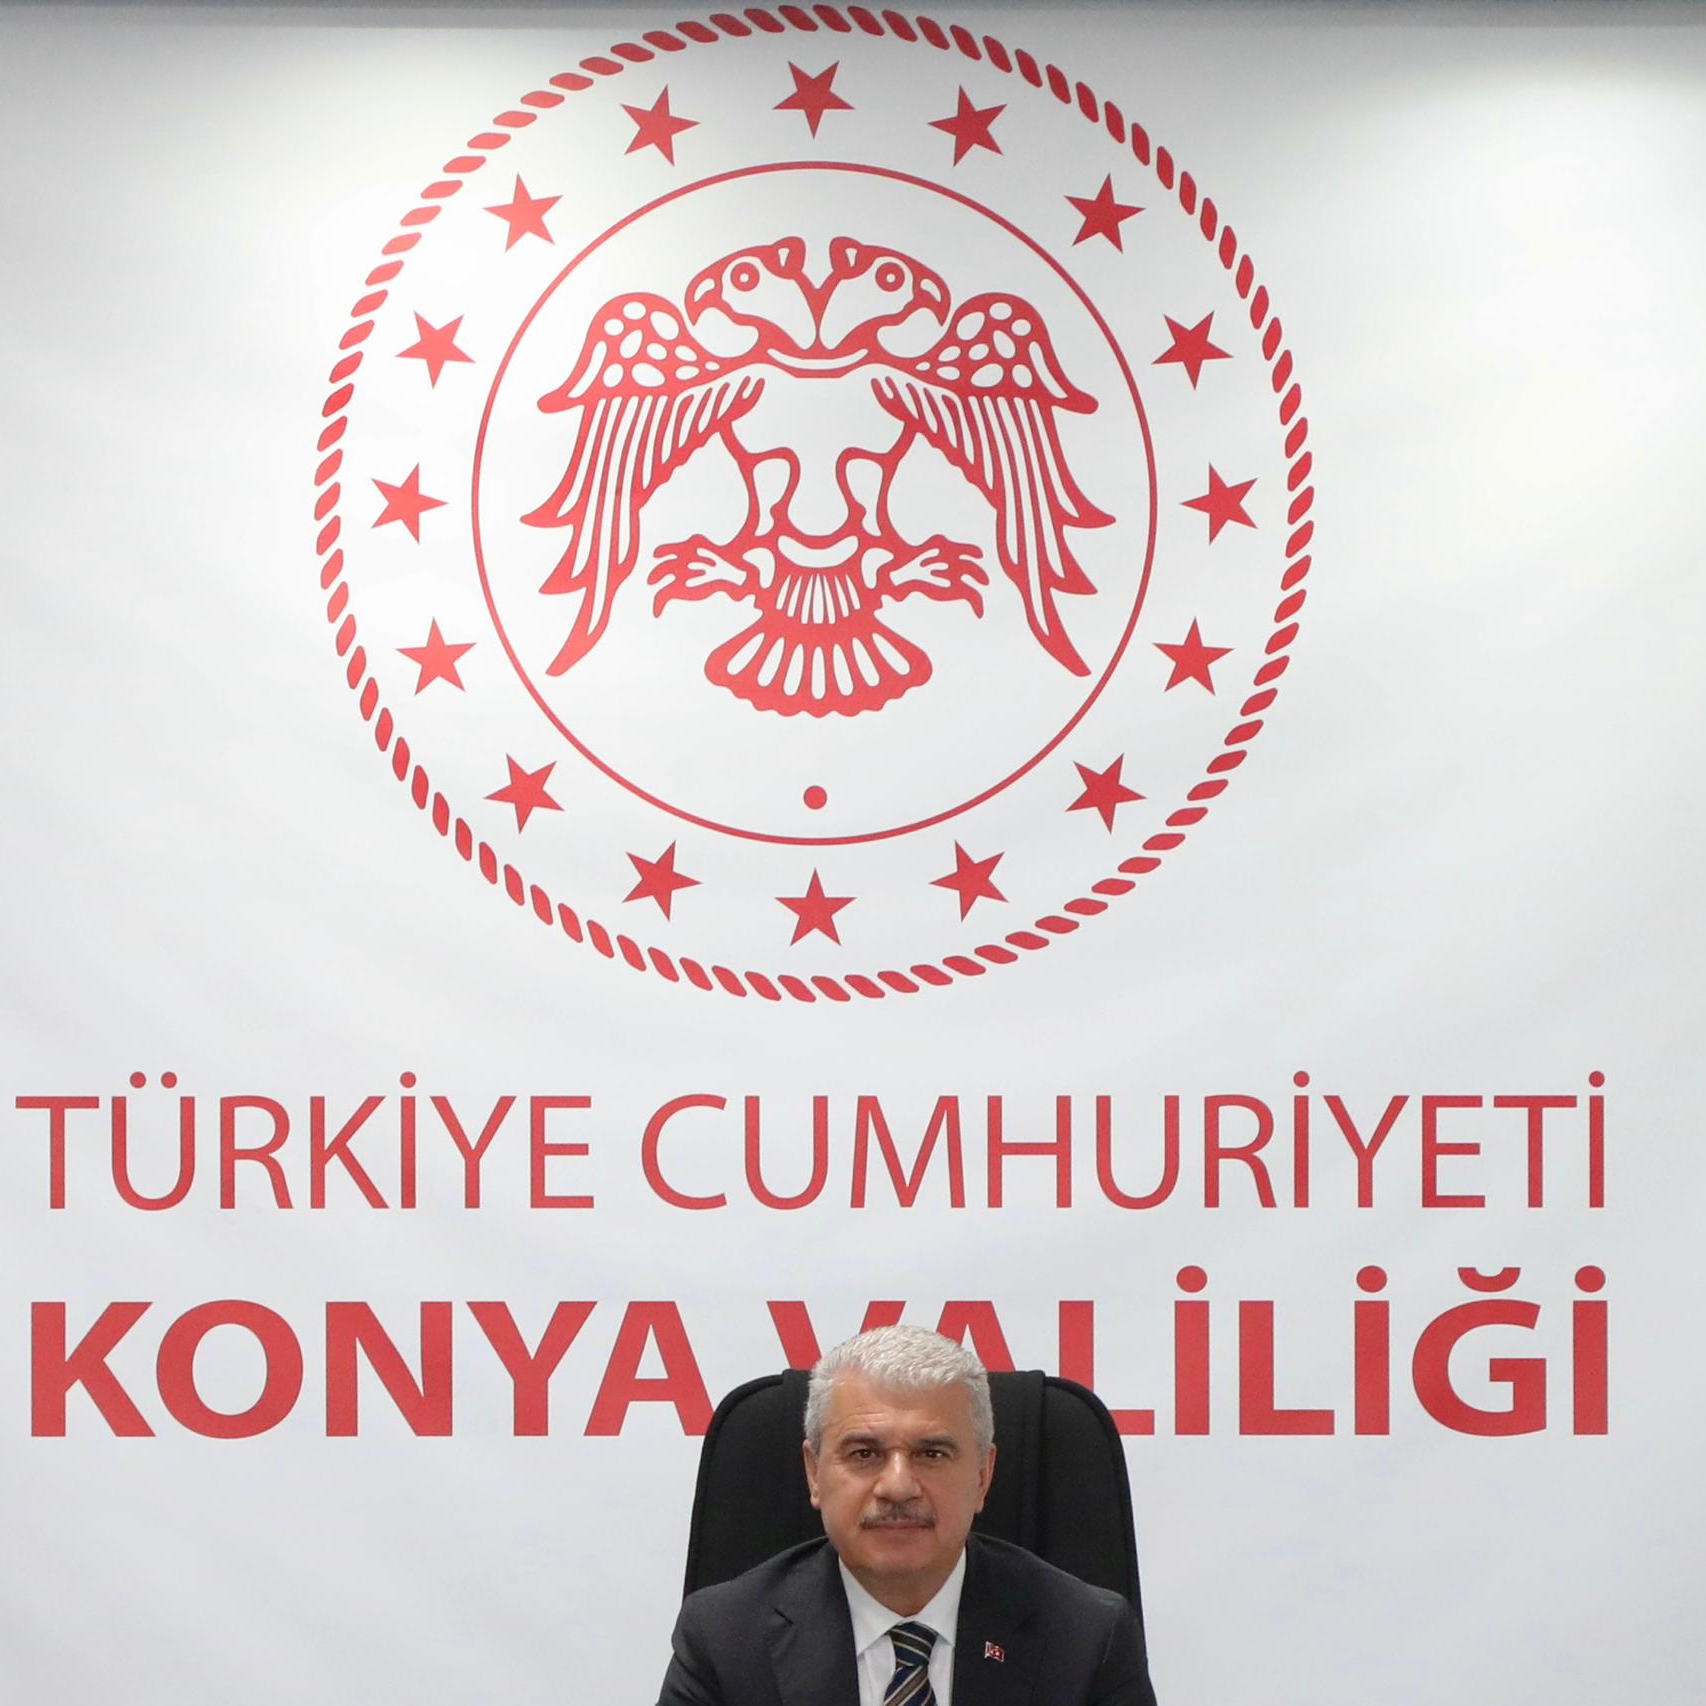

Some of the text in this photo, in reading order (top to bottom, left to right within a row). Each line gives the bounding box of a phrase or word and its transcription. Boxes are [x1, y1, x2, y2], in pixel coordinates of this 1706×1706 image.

[15, 1071, 1605, 1212] TÜRKİYE CUMHURİYETİ
[31, 1299, 716, 1440] KONYA
